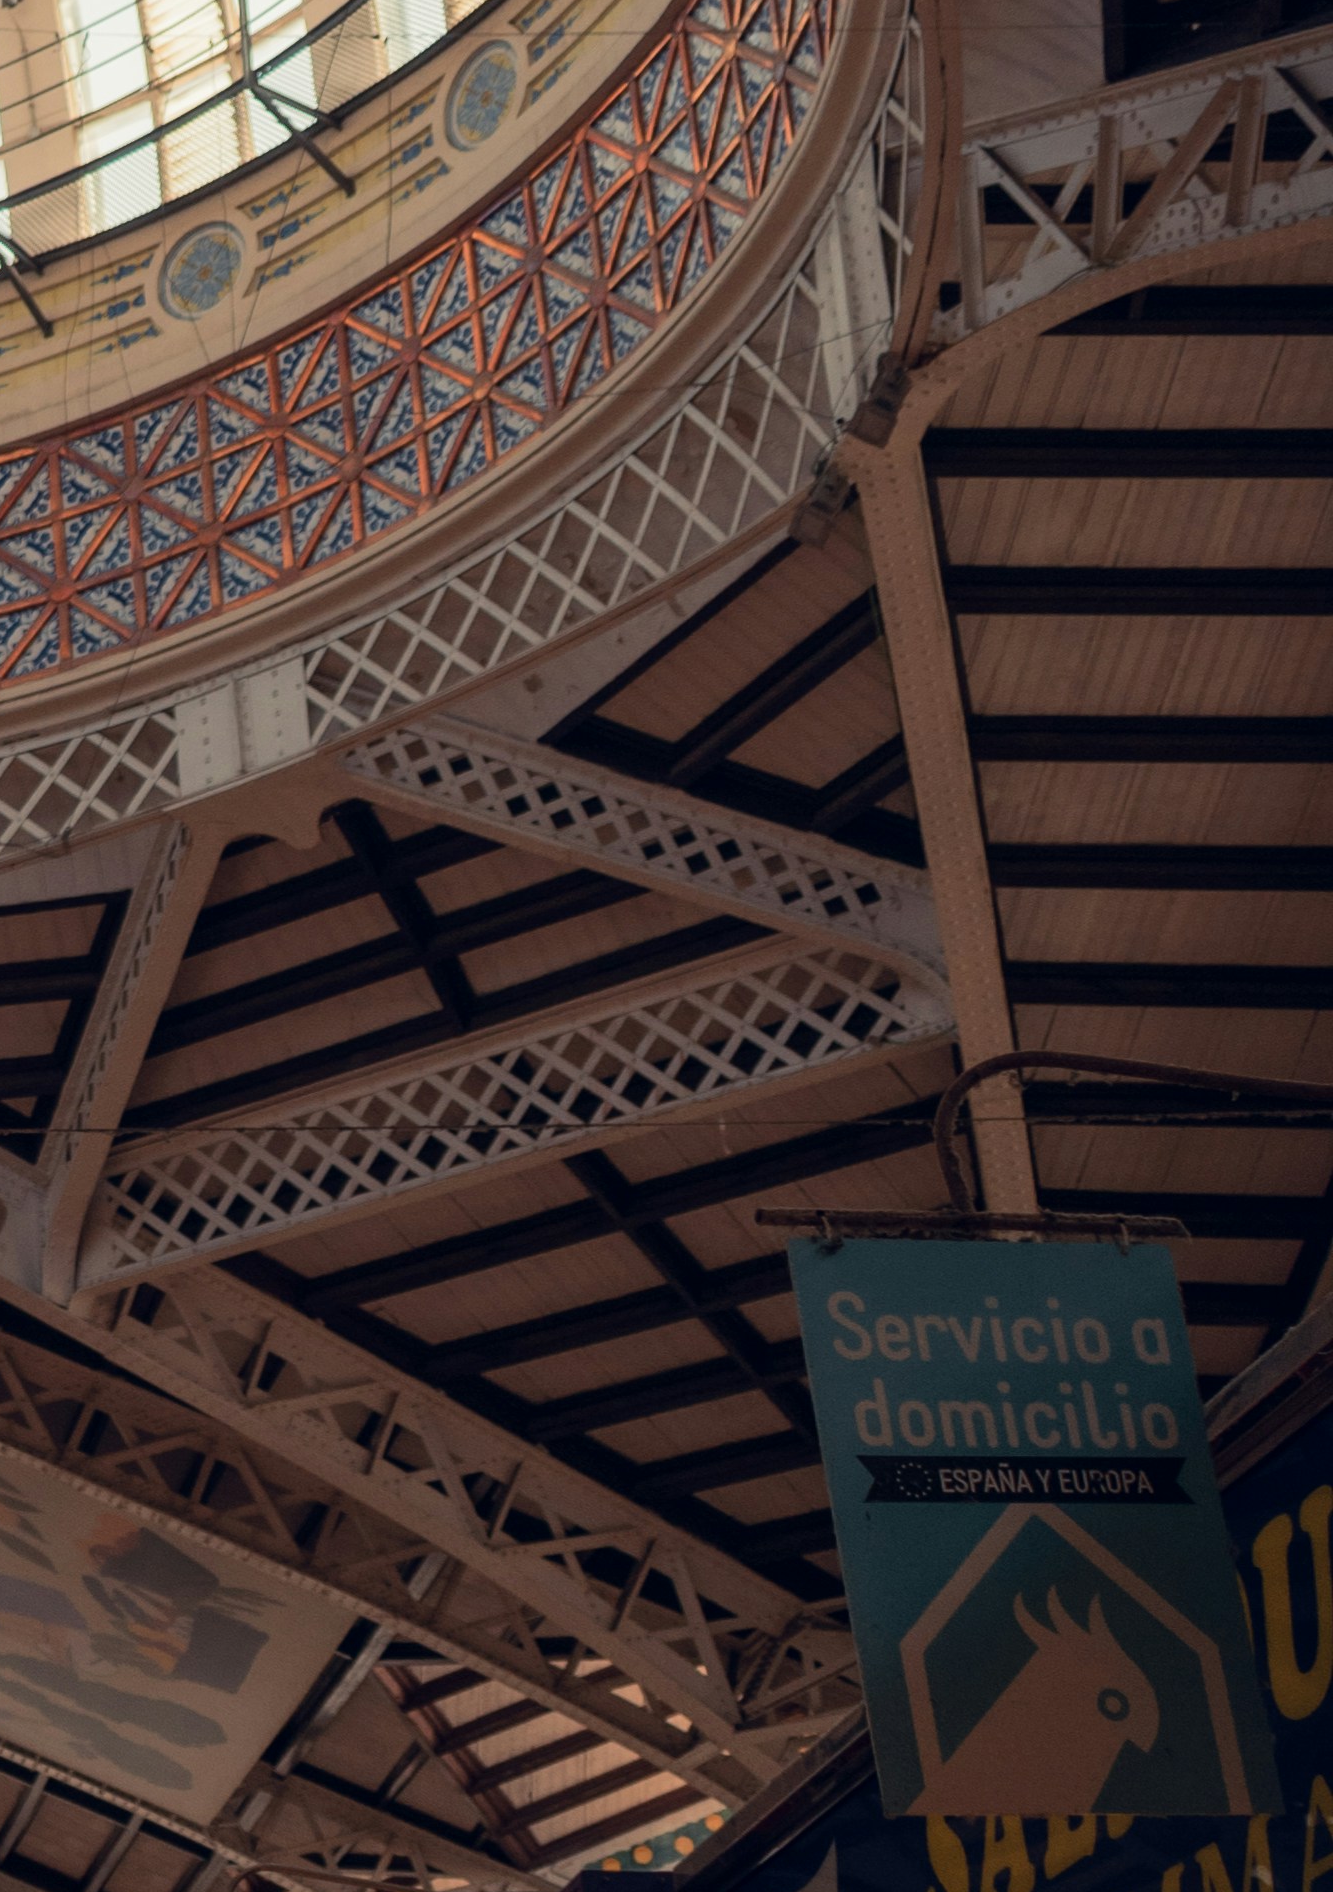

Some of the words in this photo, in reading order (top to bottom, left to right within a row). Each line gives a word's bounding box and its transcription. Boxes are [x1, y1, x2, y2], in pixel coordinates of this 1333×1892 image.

[827, 1291, 1112, 1365] Servicio
[1133, 1318, 1172, 1366] a
[854, 1378, 1180, 1450] domicilio
[940, 1462, 1033, 1495] ESPAÑA
[1035, 1469, 1054, 1493] Y
[1059, 1469, 1154, 1495] EUROPA
